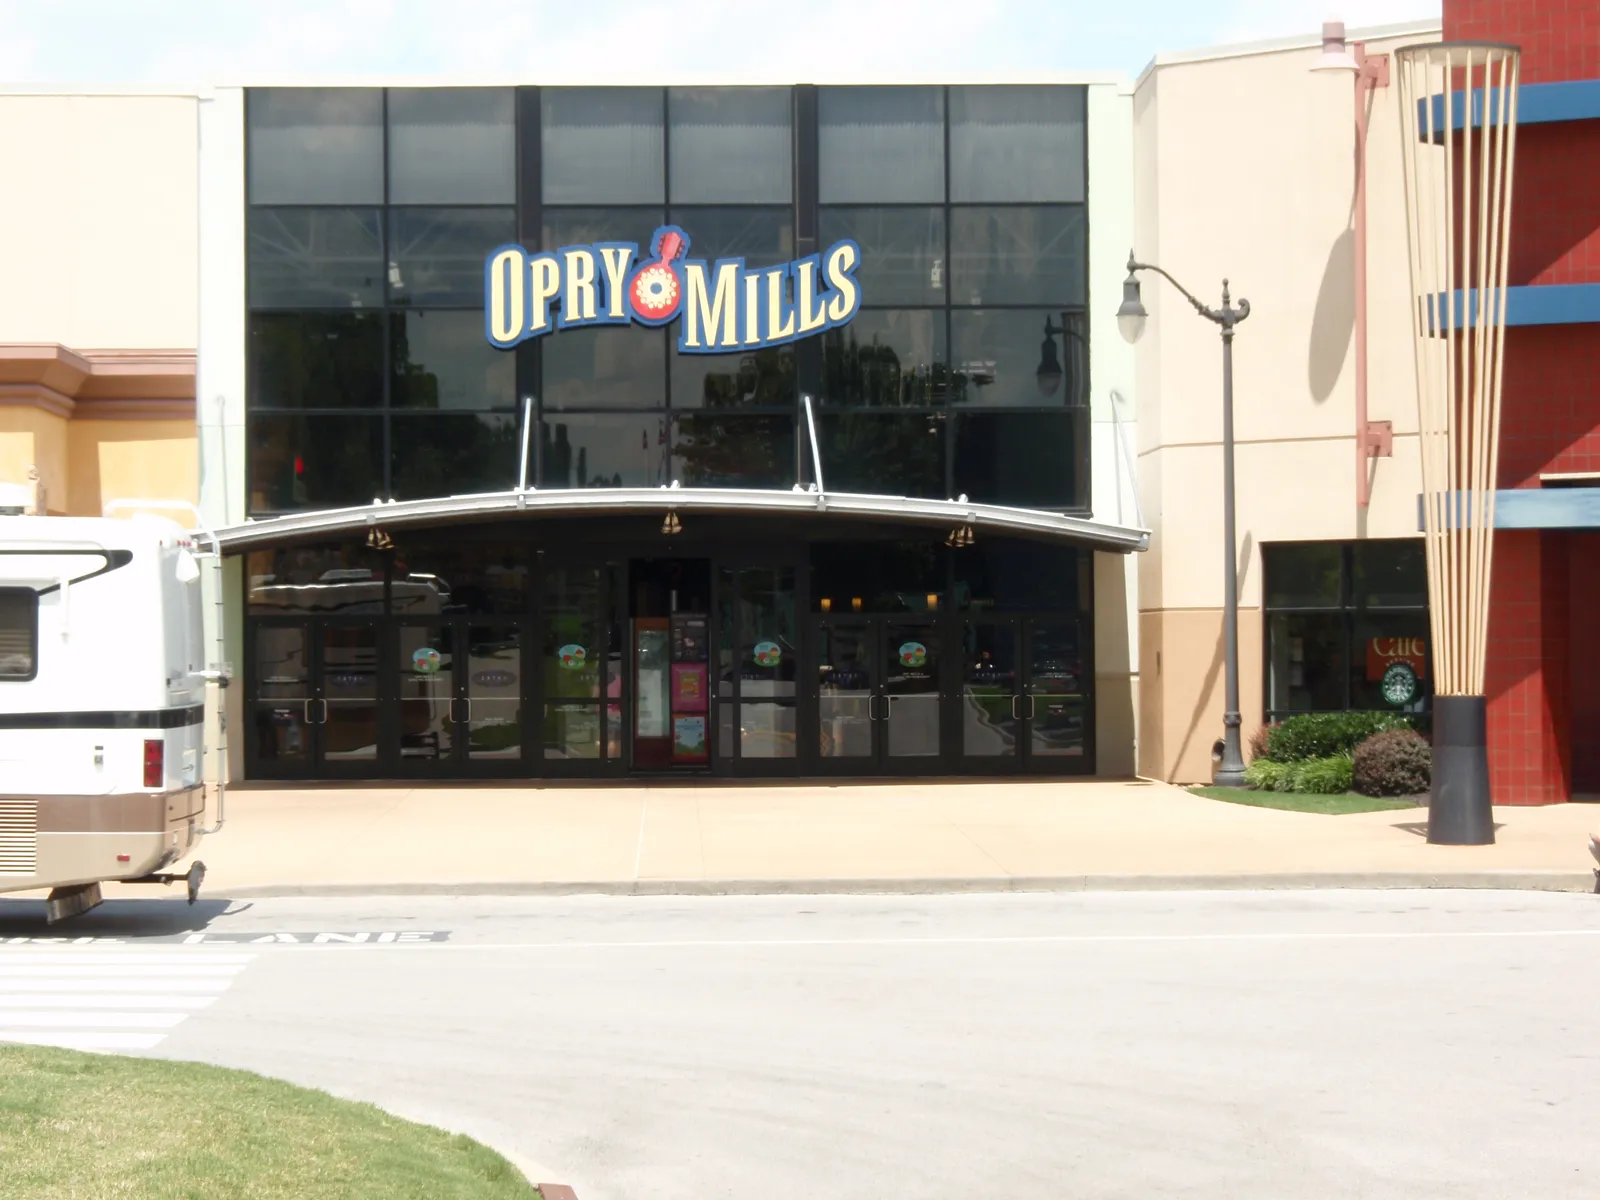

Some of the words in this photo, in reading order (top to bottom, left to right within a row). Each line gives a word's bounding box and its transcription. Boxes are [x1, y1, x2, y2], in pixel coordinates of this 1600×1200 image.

[490, 247, 632, 343] OPRY
[684, 244, 856, 348] MILLS
[182, 931, 434, 944] LANE
